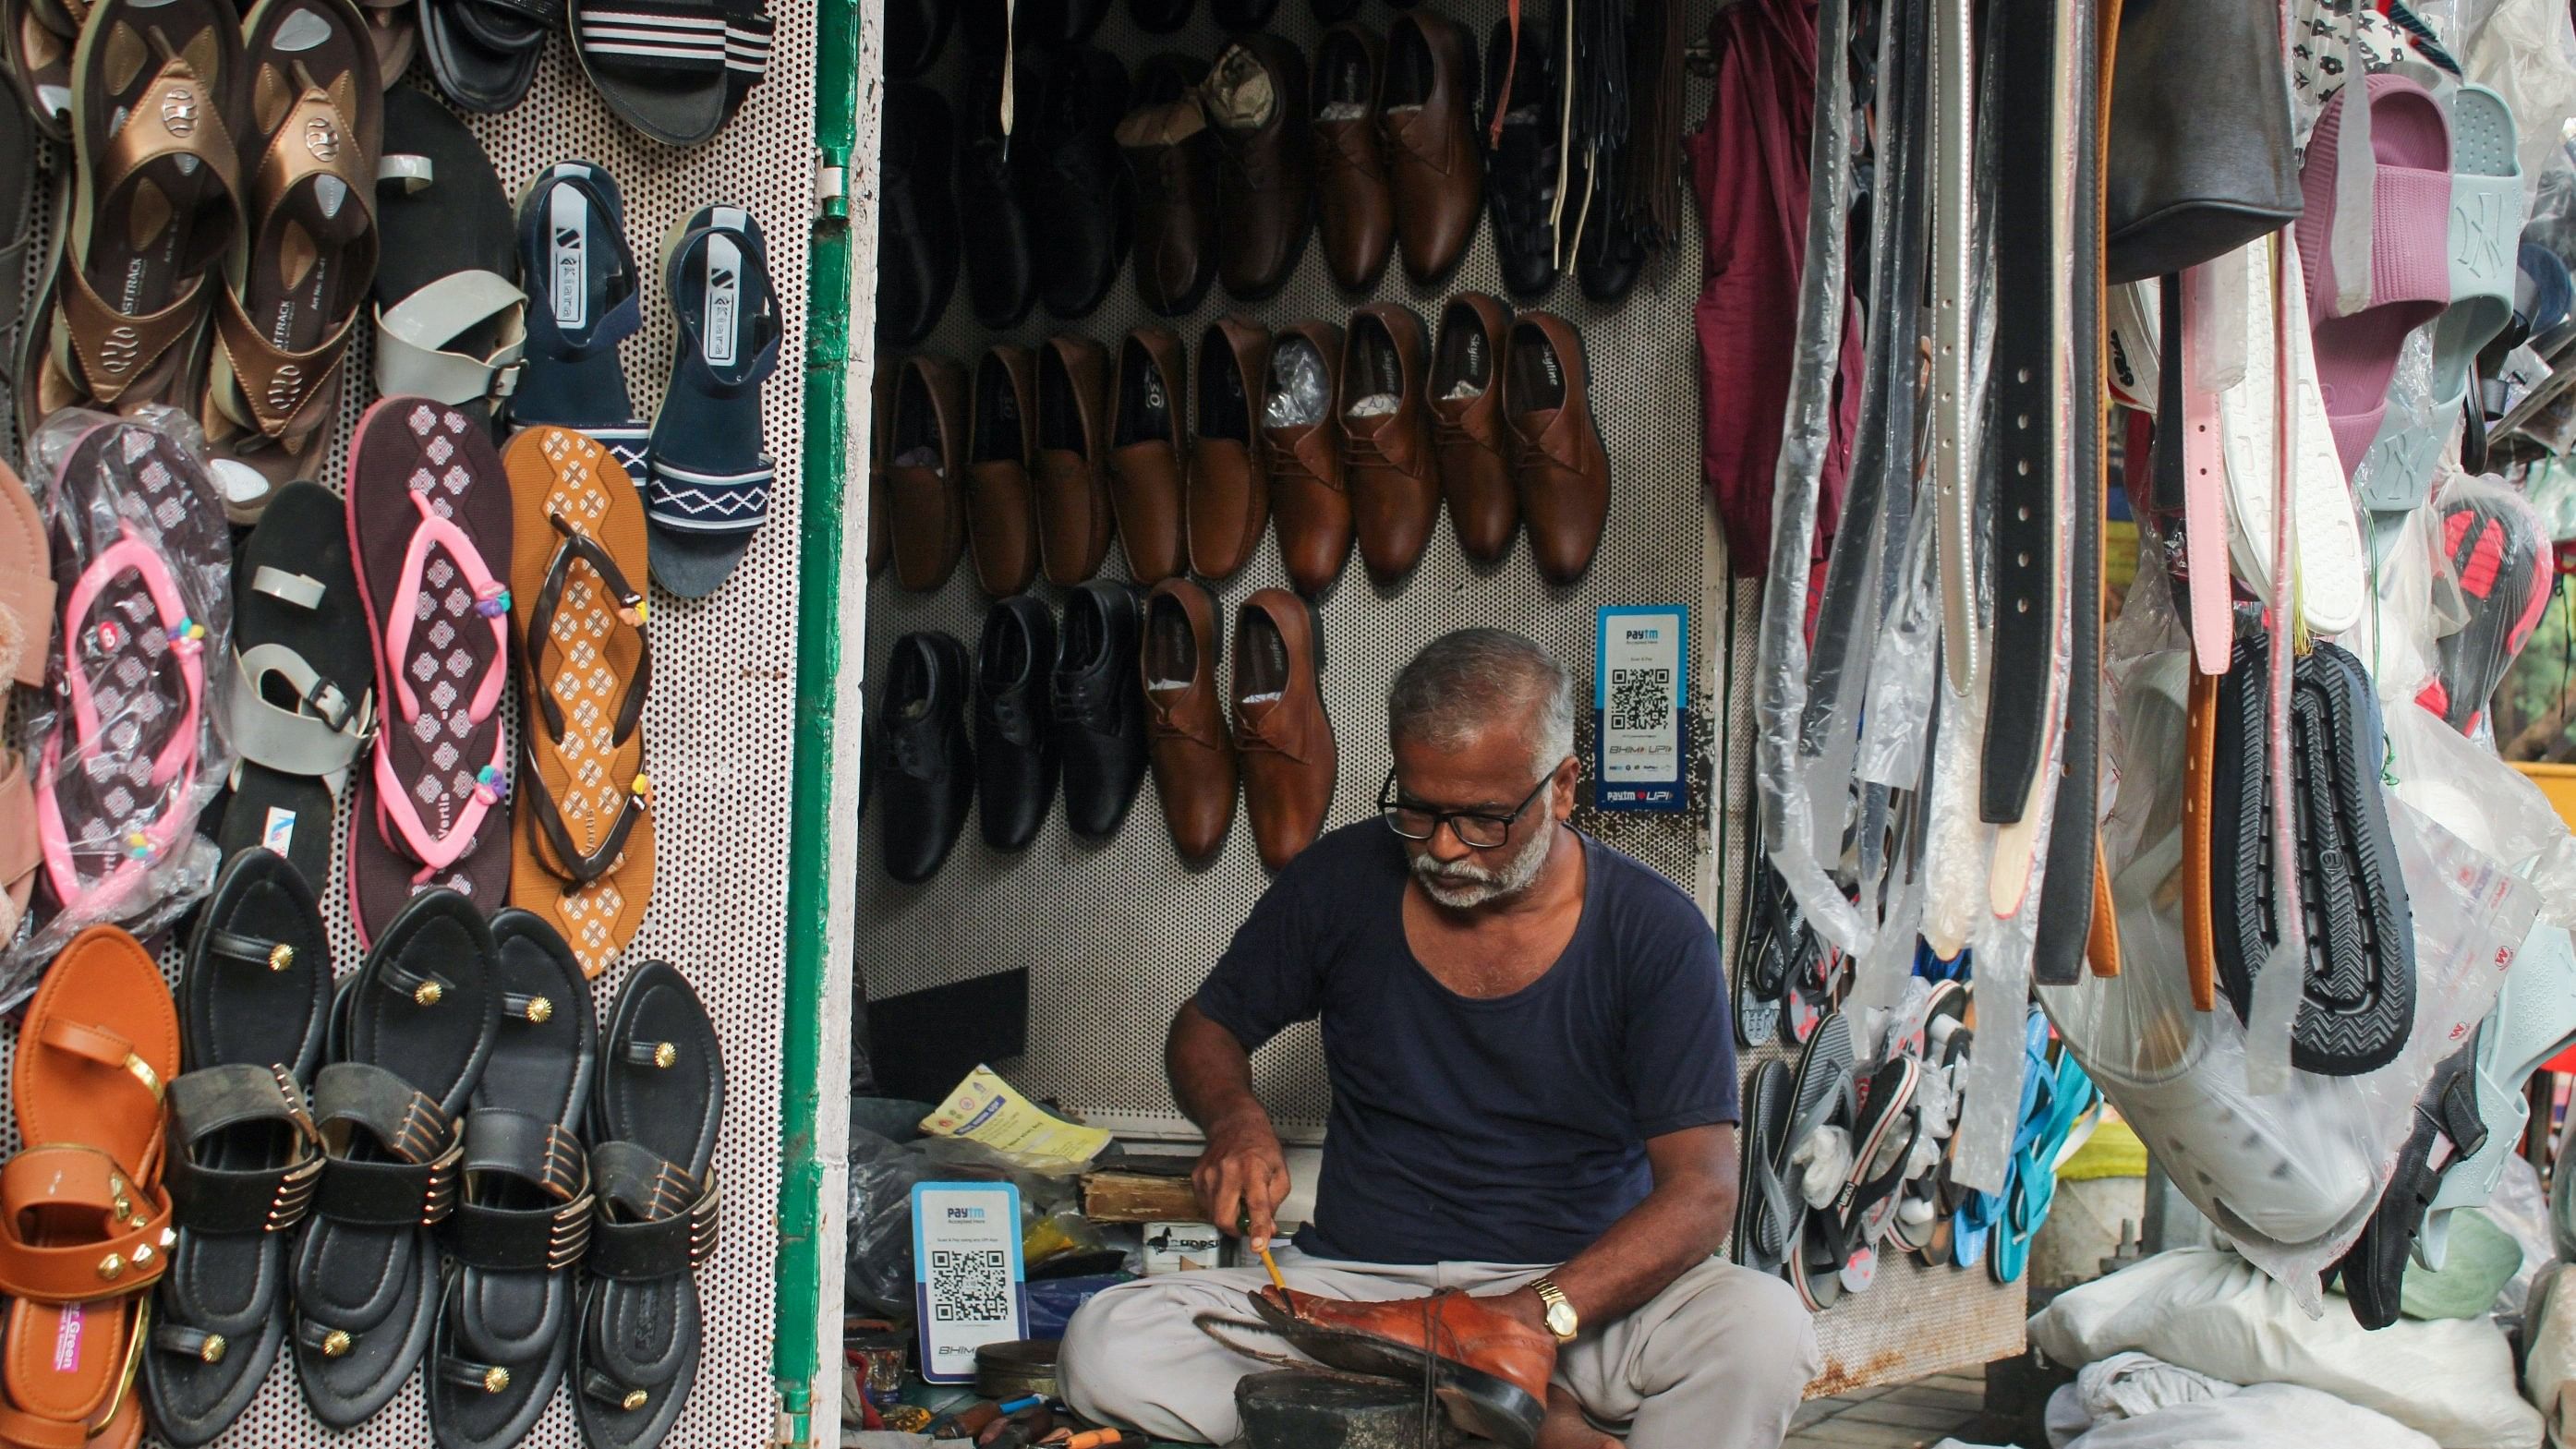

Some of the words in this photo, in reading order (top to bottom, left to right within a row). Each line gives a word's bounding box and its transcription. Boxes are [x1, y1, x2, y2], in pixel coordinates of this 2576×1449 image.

[562, 267, 575, 317] Kiara
[1382, 350, 1396, 391] Skyline
[1468, 333, 1481, 377] Skyline
[1542, 344, 1558, 385] Skyline
[1626, 630, 1658, 640] paytm
[1610, 745, 1639, 754] BHIM
[1649, 745, 1668, 754] UPI
[438, 792, 450, 839] Vertis
[1607, 791, 1636, 802] paytm
[1646, 791, 1670, 801] UPI
[584, 809, 596, 854] Vertis
[948, 1208, 985, 1218] paytm
[63, 1321, 80, 1370] Green
[938, 1346, 975, 1355] BHIM
